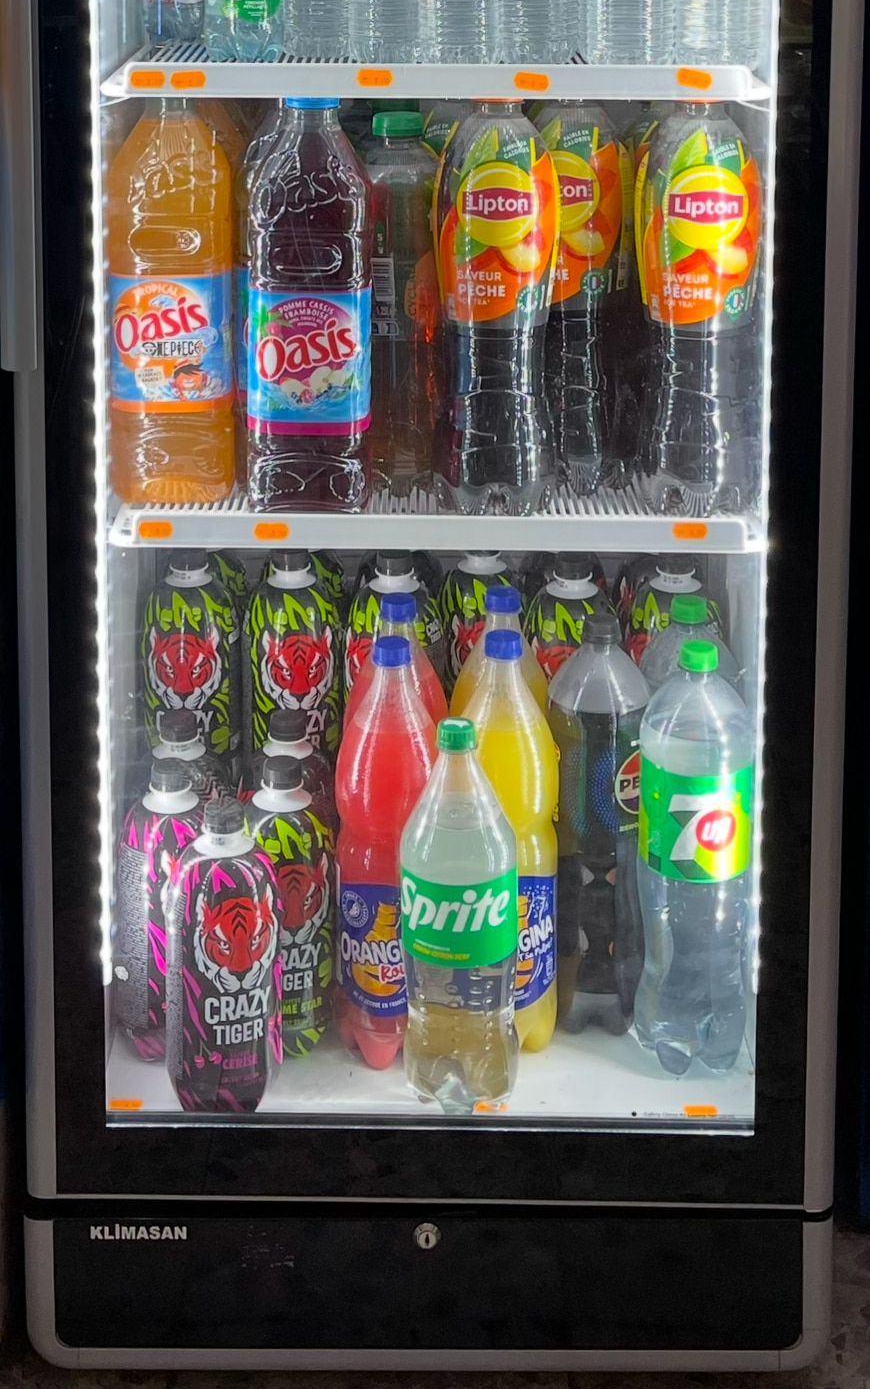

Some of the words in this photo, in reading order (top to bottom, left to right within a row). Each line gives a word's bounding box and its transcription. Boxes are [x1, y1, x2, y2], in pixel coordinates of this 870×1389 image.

[563, 130, 582, 142] FAIBLE
[563, 135, 592, 149] CALORIES
[560, 185, 588, 199] ton
[468, 195, 529, 215] Lipton
[674, 197, 739, 218] Lipton
[457, 270, 502, 282] SAVEUR
[662, 272, 709, 284] SAVEUR
[132, 283, 178, 296] TROPICAL
[458, 281, 506, 297] PÊCHE
[663, 283, 713, 300] PÊCHE
[278, 301, 307, 313] POMME
[309, 300, 335, 316] CASSIS
[285, 307, 329, 320] FRAMBOISE
[114, 296, 209, 353] Oasis
[257, 318, 358, 382] Oasis
[401, 876, 511, 933] Sprite
[281, 942, 322, 971] RAZY
[341, 931, 405, 965] ORANGI
[283, 970, 314, 991] GER
[204, 986, 271, 1024] CRAZY
[213, 1018, 264, 1045] TIGER
[223, 1053, 258, 1069] CERISE
